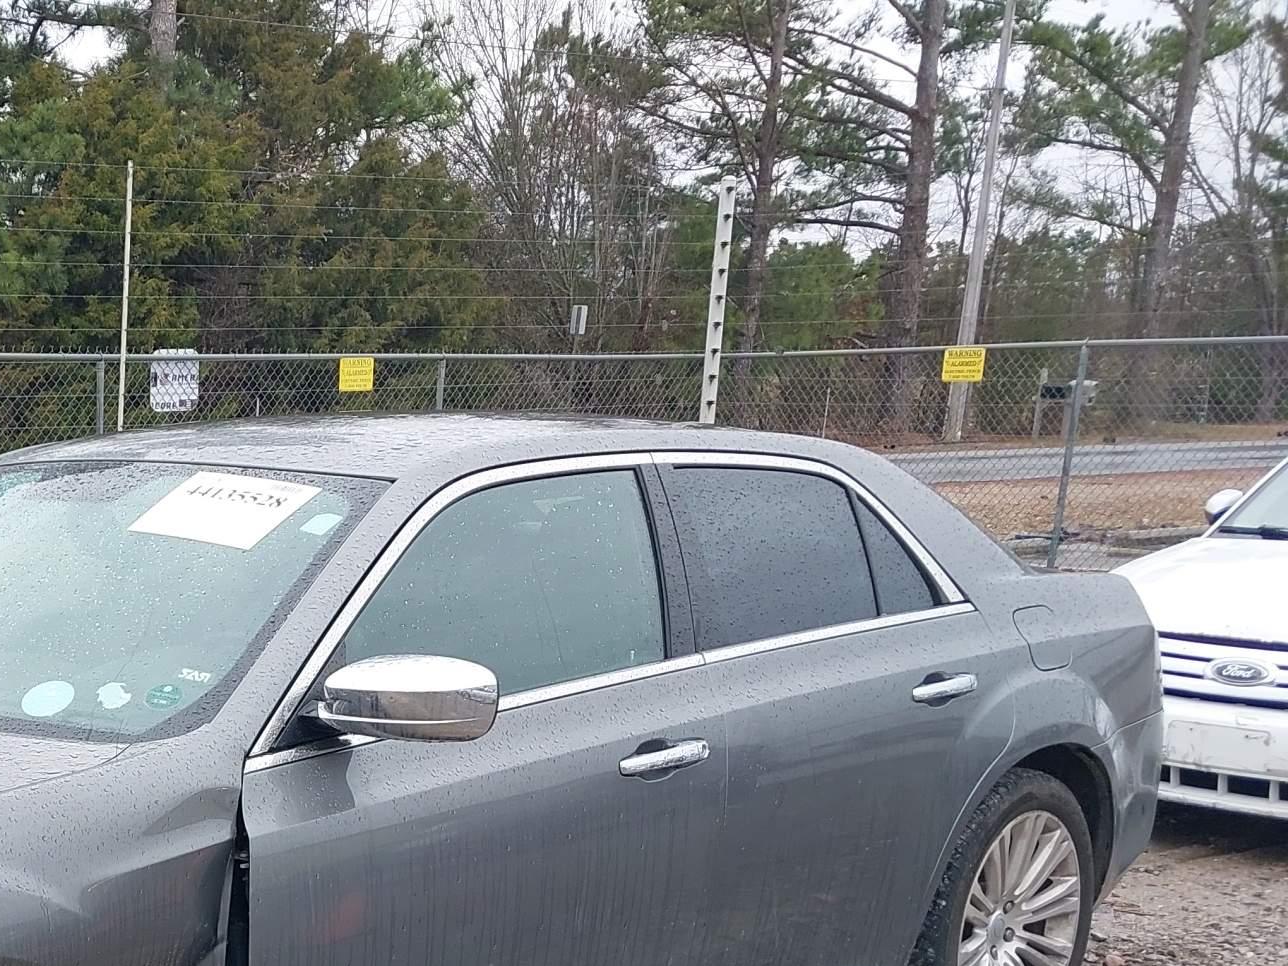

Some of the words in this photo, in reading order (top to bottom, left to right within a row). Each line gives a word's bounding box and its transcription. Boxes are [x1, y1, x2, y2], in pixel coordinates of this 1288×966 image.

[948, 349, 982, 357] WARNING
[342, 359, 372, 367] WARNING
[186, 485, 288, 507] 44135528
[1222, 663, 1256, 678] Ford
